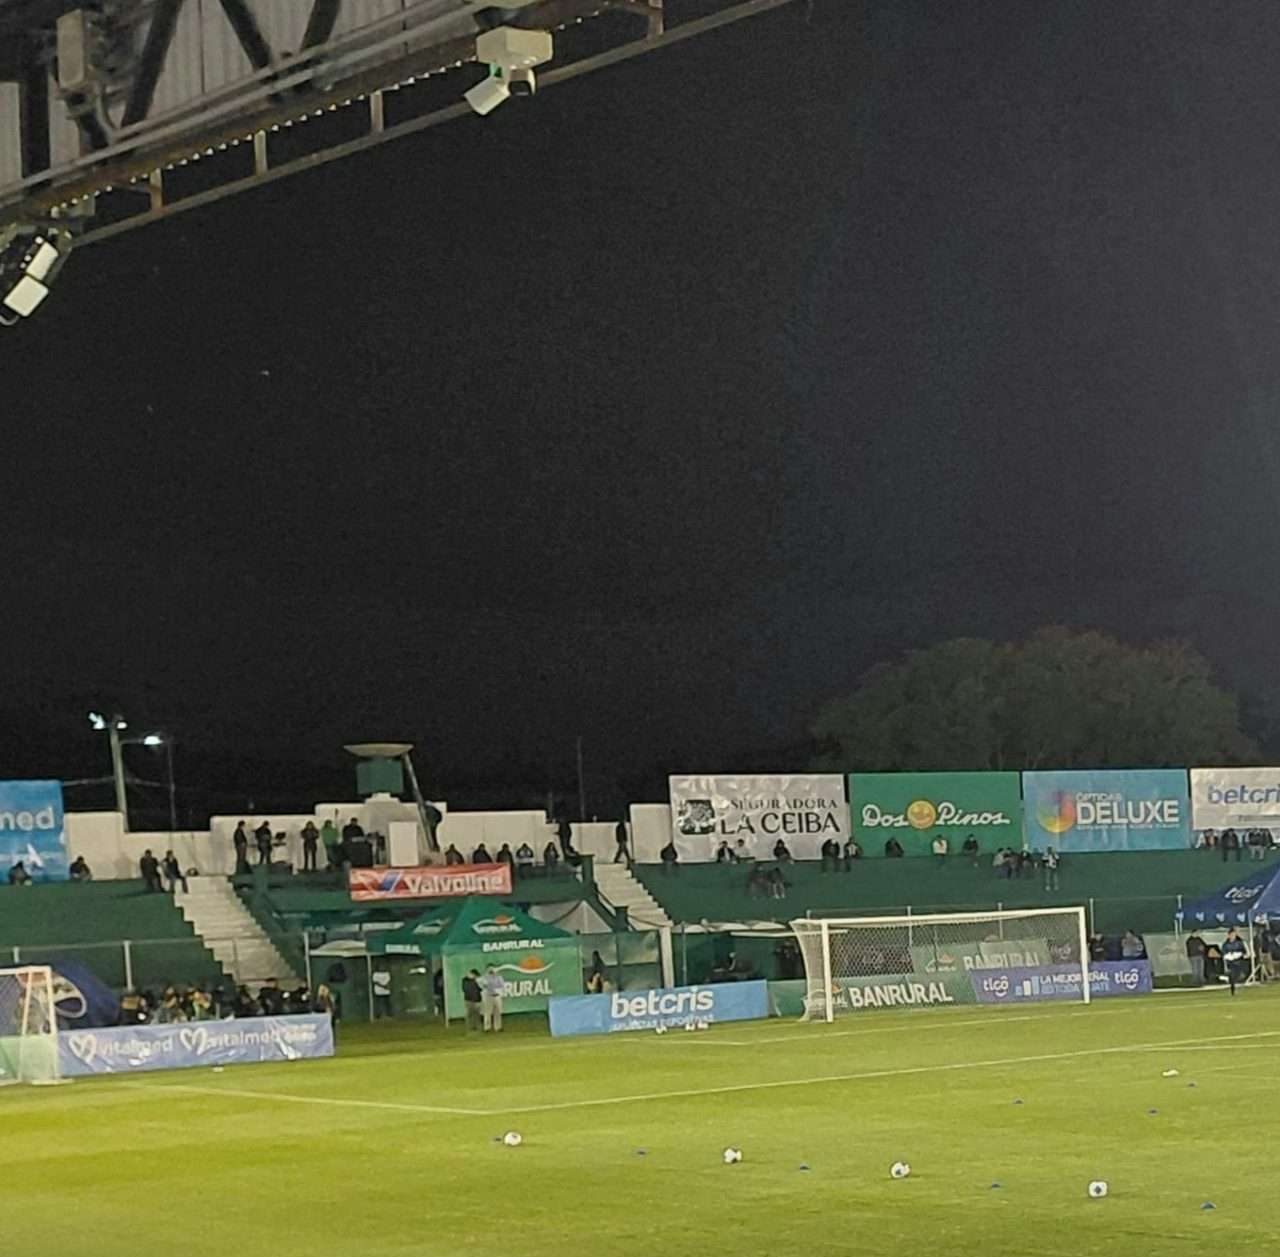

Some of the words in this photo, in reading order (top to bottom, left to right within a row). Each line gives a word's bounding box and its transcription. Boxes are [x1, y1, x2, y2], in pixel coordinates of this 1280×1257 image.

[722, 797, 838, 810] SEGURADORA
[862, 803, 909, 827] Dos
[935, 801, 1011, 826] Pinos
[1076, 800, 1180, 825] DELUXE
[720, 814, 756, 835] LA
[760, 811, 841, 835] CEIBA
[405, 872, 504, 894] Valvoline
[501, 978, 553, 998] RURAL
[849, 982, 954, 1008] BANRURAL
[610, 986, 714, 1019] betcris
